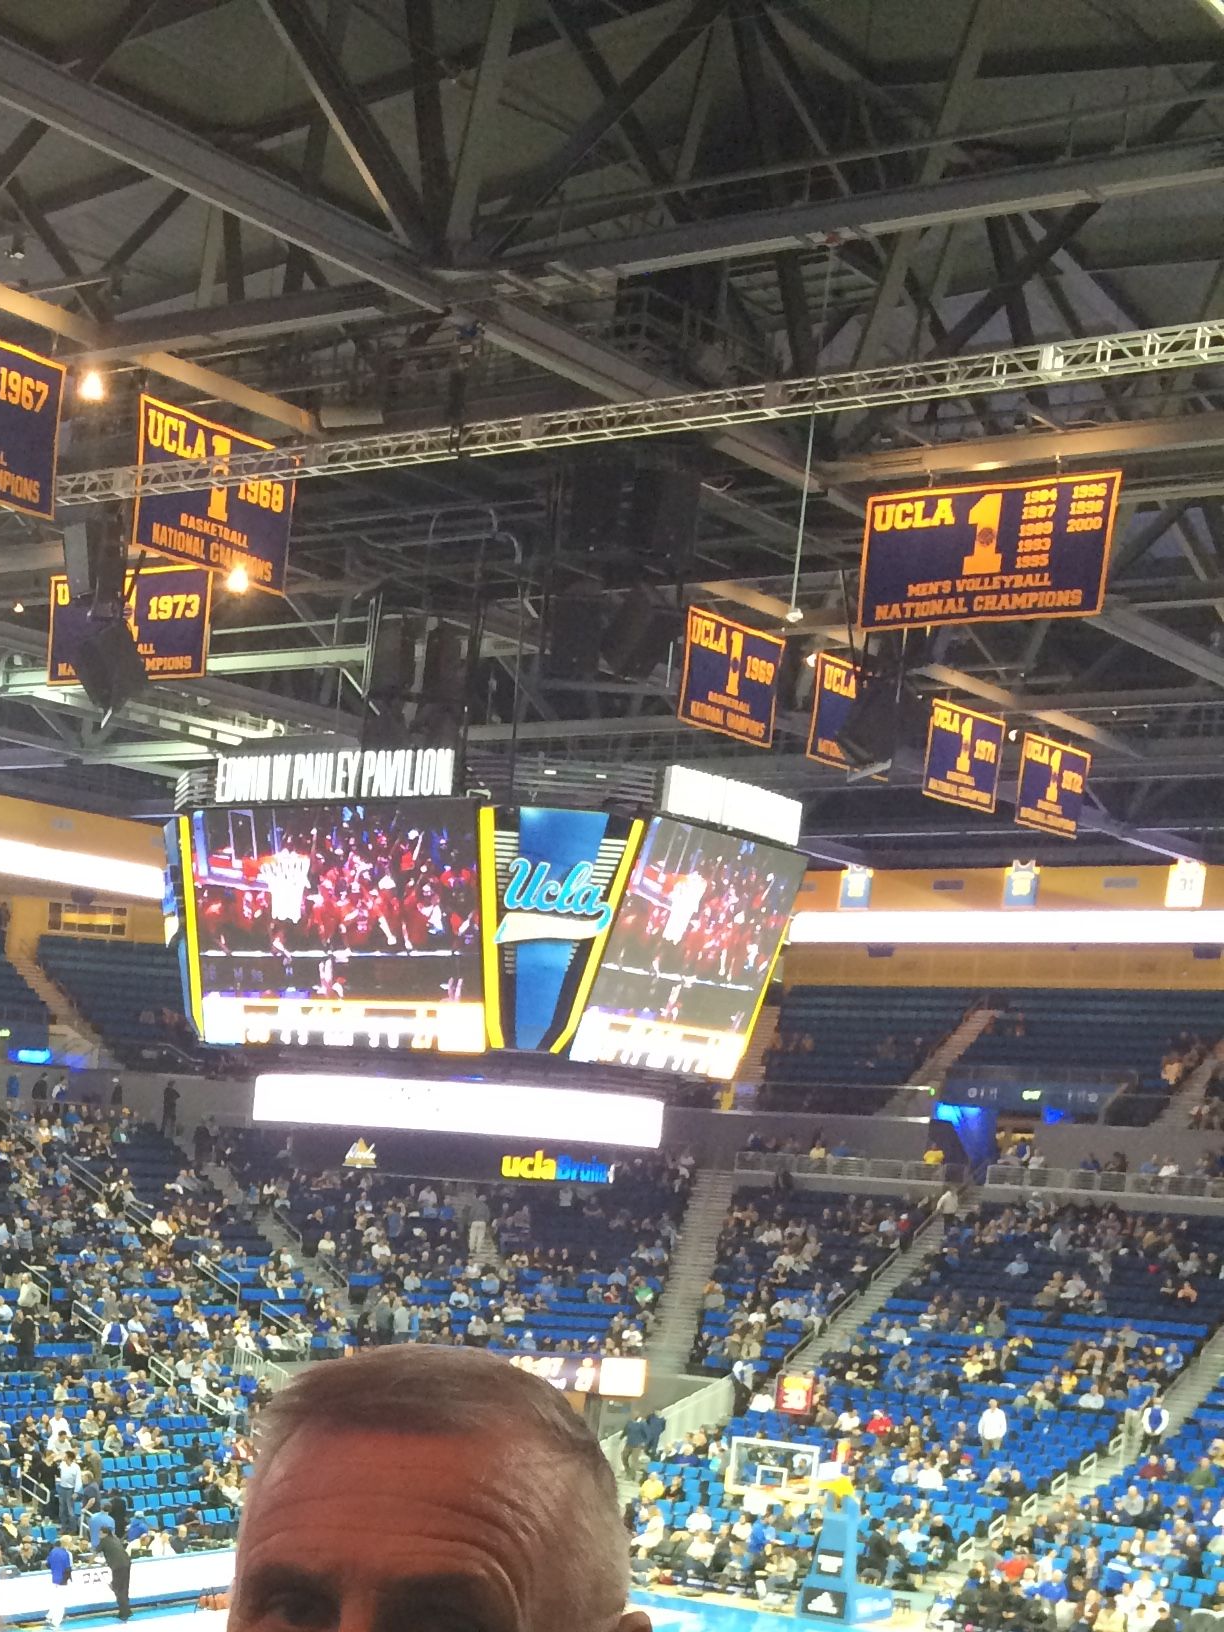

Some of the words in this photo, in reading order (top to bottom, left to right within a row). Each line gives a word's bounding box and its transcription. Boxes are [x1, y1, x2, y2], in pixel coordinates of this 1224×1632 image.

[148, 409, 207, 464] UCLA
[238, 477, 284, 513] 1968
[180, 513, 249, 548] BASKETBALL
[874, 498, 955, 532] UCLA
[152, 522, 205, 560] NATIONAL
[907, 580, 952, 597] MEN'S
[956, 572, 1051, 593] VOLLEYBALL
[148, 594, 201, 620] 1973
[875, 597, 968, 621] NATIONAL
[973, 589, 1083, 612] CHAMPIONS
[691, 615, 727, 654] UCLA
[145, 656, 191, 671] MPIONS
[292, 751, 361, 799] PAULEY
[361, 749, 455, 797] PAVILION
